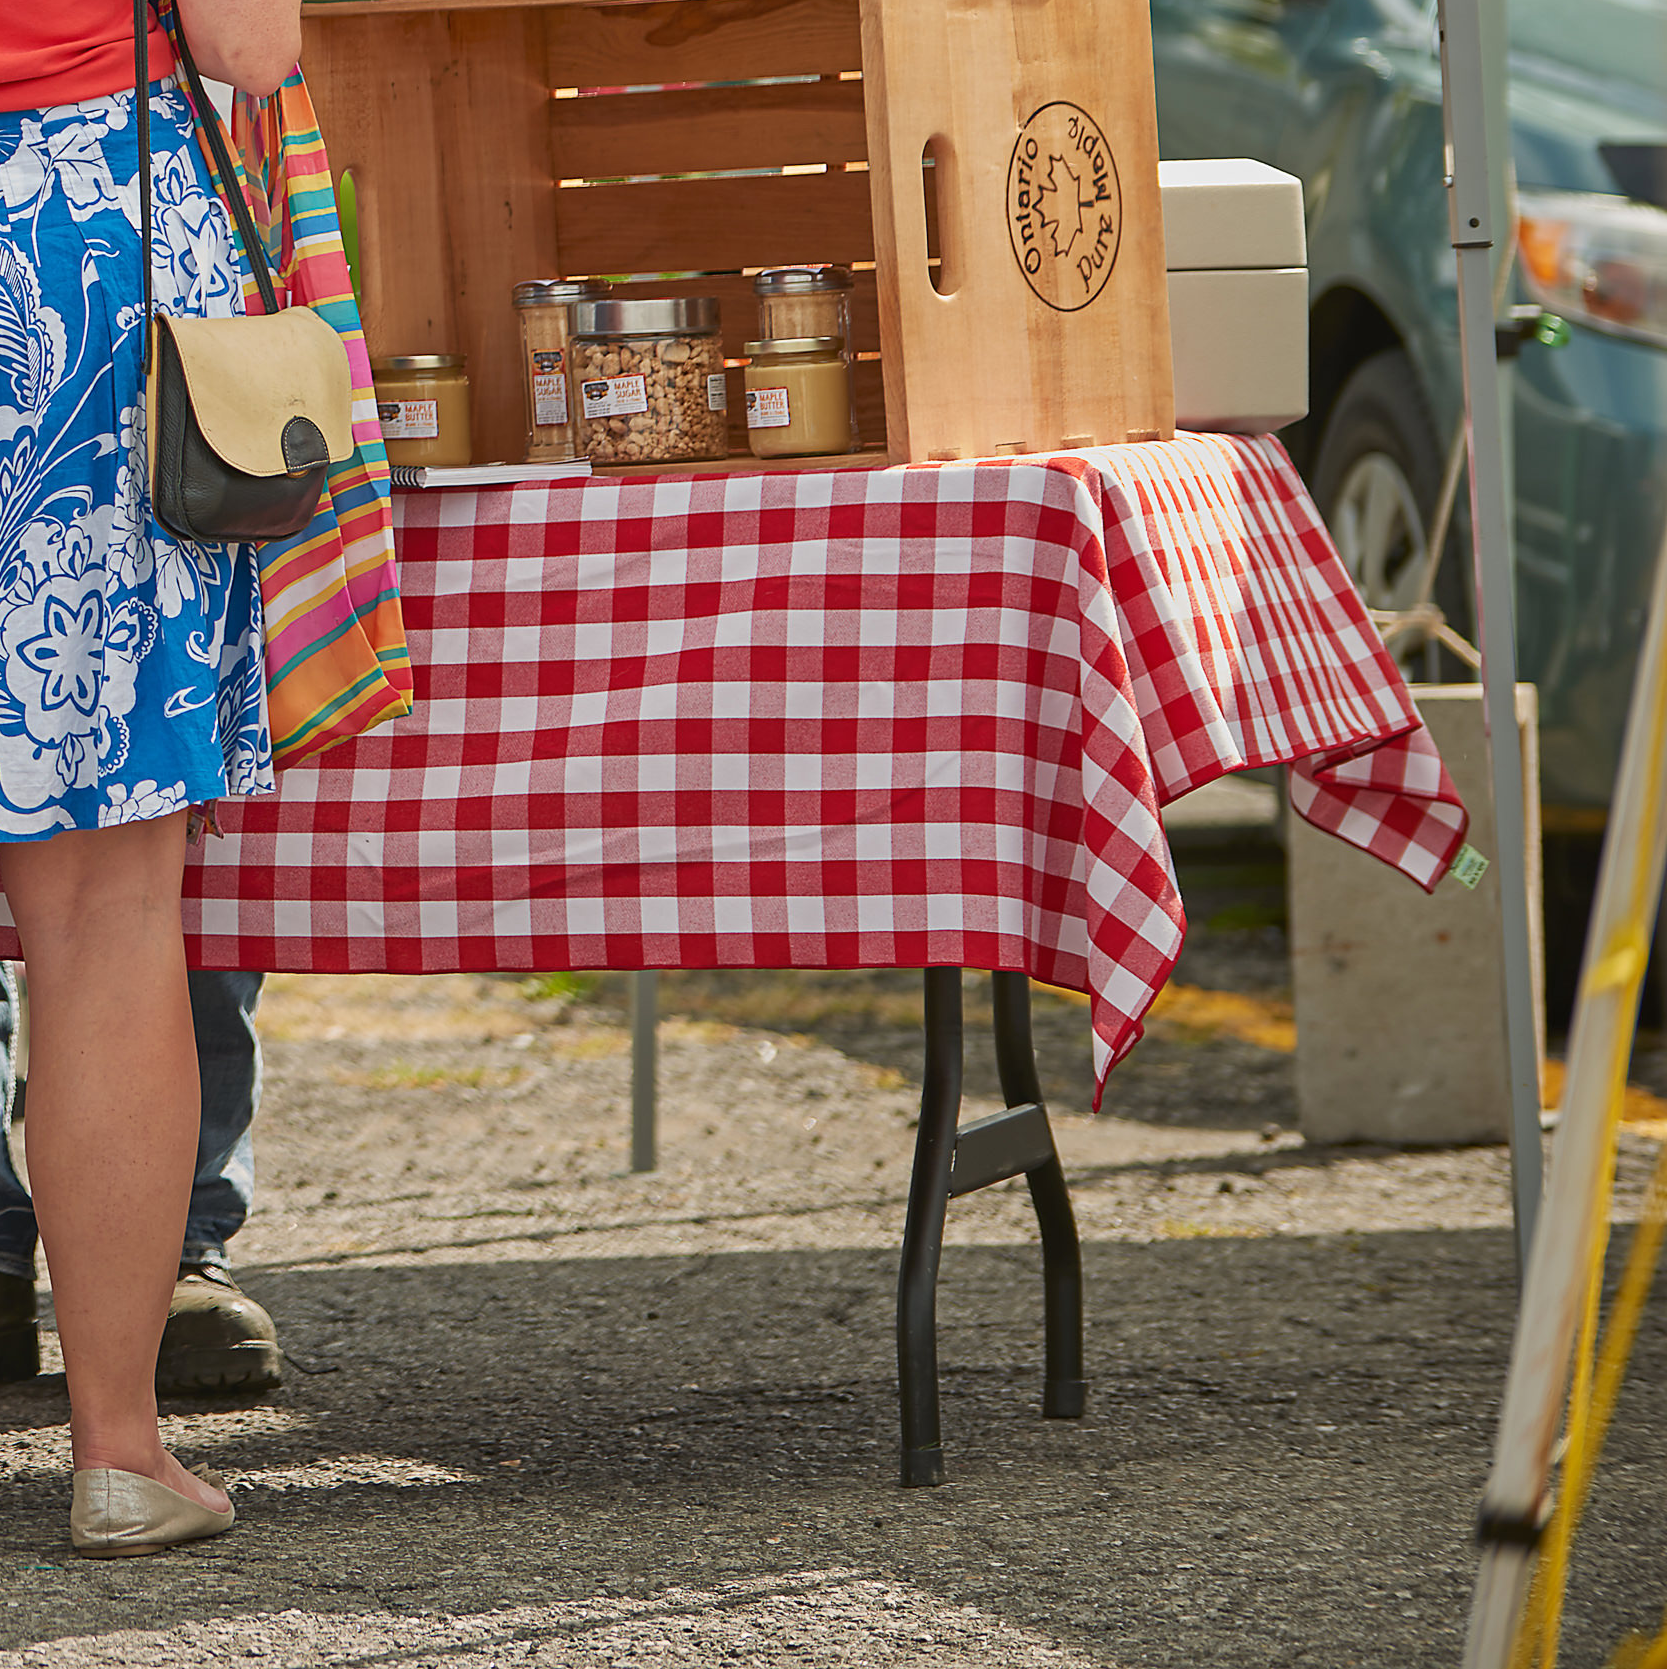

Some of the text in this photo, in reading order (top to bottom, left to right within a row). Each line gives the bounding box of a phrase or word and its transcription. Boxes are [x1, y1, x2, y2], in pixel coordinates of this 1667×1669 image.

[1068, 115, 1112, 203] Maple
[1015, 137, 1042, 276] Ontario
[535, 377, 562, 386] MAPLE
[613, 379, 640, 390] MAPLE
[536, 386, 563, 396] SUGAR
[615, 389, 642, 399] SUGAR
[759, 392, 784, 402] MAPLE
[404, 403, 433, 413] MAPLE
[759, 401, 785, 411] BUTTER
[404, 412, 434, 422] BUTTER
